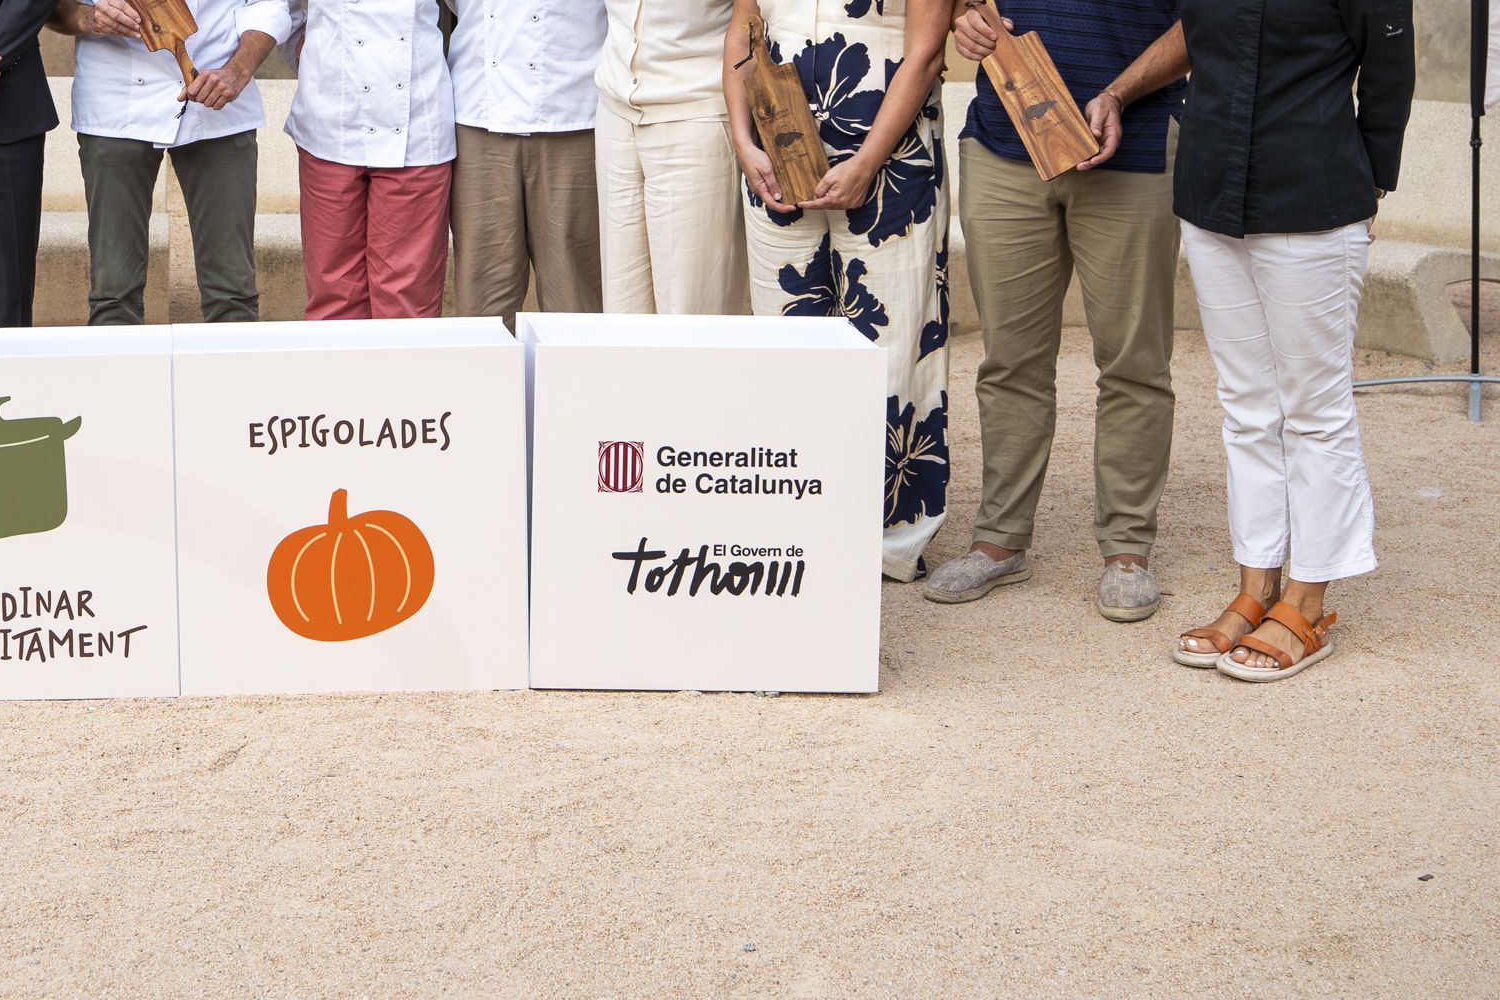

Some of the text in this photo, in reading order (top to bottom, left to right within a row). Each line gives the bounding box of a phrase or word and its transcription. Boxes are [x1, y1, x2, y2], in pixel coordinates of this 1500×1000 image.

[249, 411, 452, 456] ESPIGOLADES
[656, 446, 798, 468] Generalitat
[655, 473, 823, 501] de Catalunya
[713, 544, 804, 558] El Govern de
[1, 586, 96, 622] DINAR
